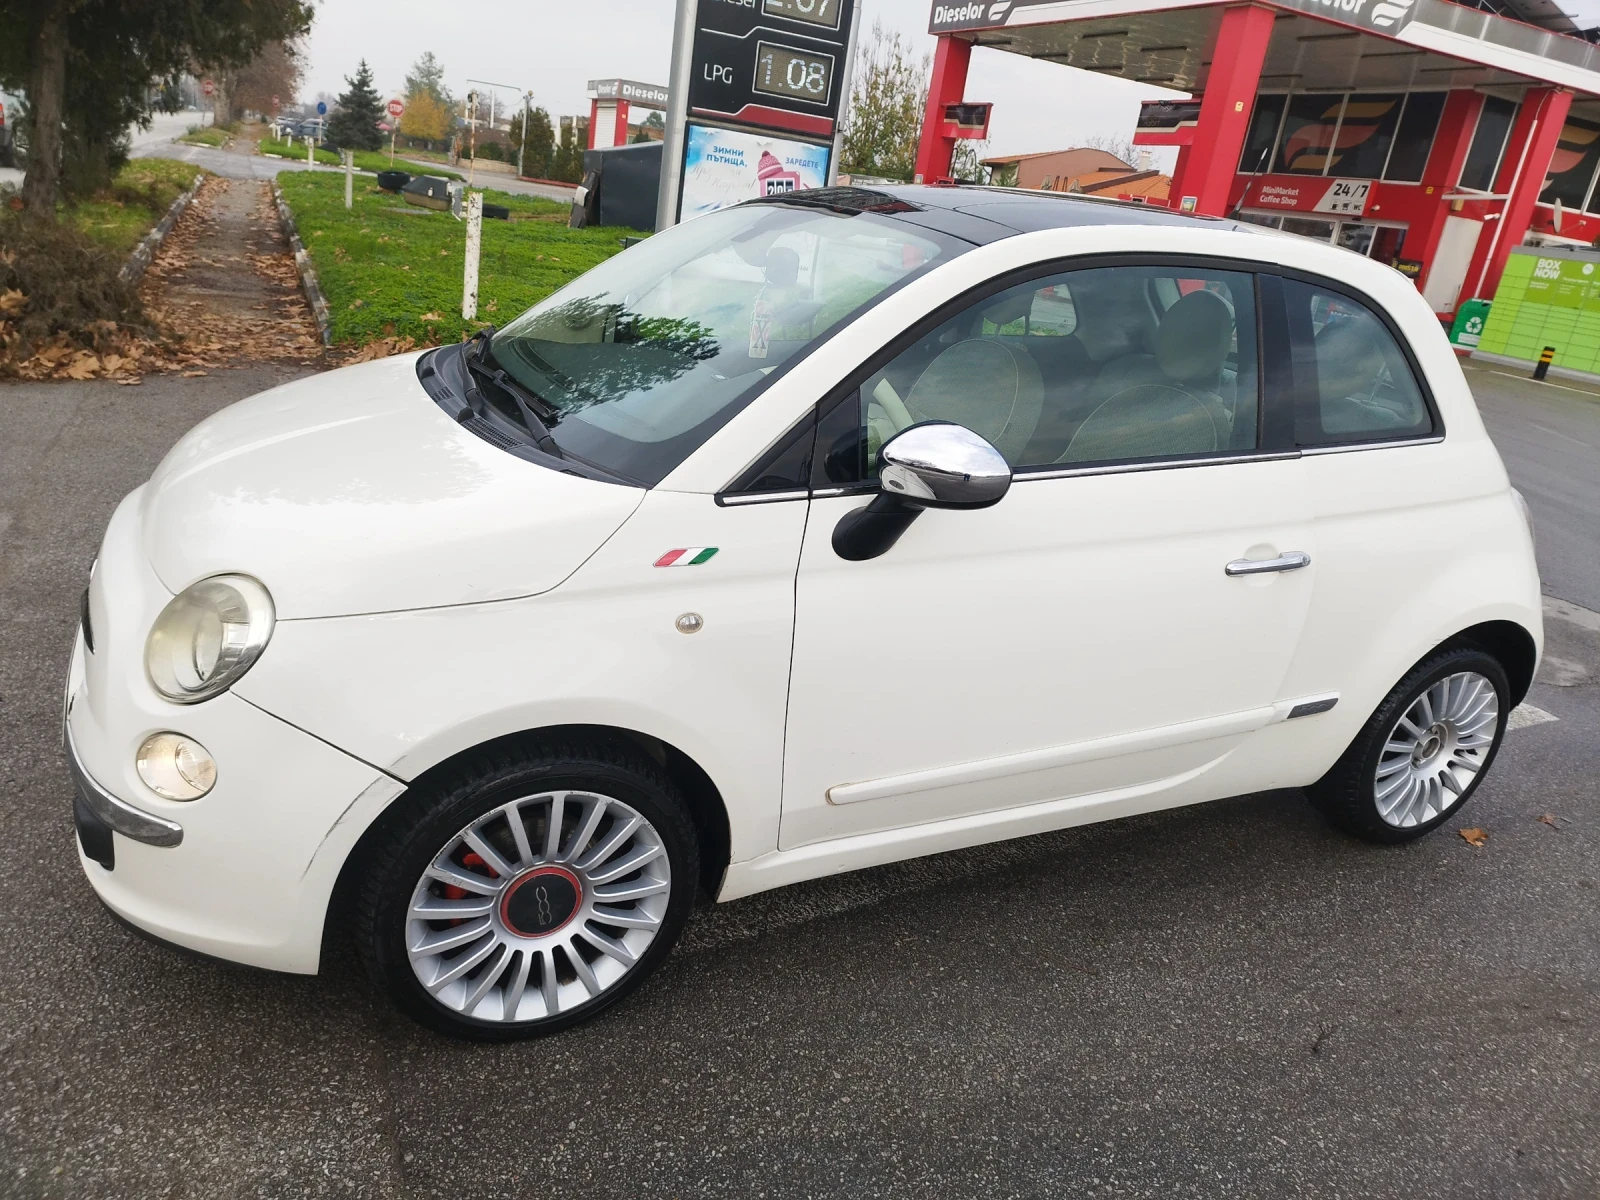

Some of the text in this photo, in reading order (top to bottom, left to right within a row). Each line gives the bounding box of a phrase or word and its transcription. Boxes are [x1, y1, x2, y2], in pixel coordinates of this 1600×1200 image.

[934, 2, 986, 24] Dieselor
[704, 63, 733, 84] LPG
[761, 54, 825, 93] 1.08
[389, 103, 403, 113] STOP
[713, 145, 744, 158] ЗИМНИ
[706, 153, 748, 168] ПЪТИЩА,
[785, 157, 819, 169] ЗАРЕДЕТЕ
[1262, 185, 1299, 196] MiniMarket
[1333, 183, 1369, 198] 24/7
[1260, 195, 1298, 206] Coffee Shop
[1538, 258, 1562, 270] BOX
[1533, 267, 1561, 280] NOW
